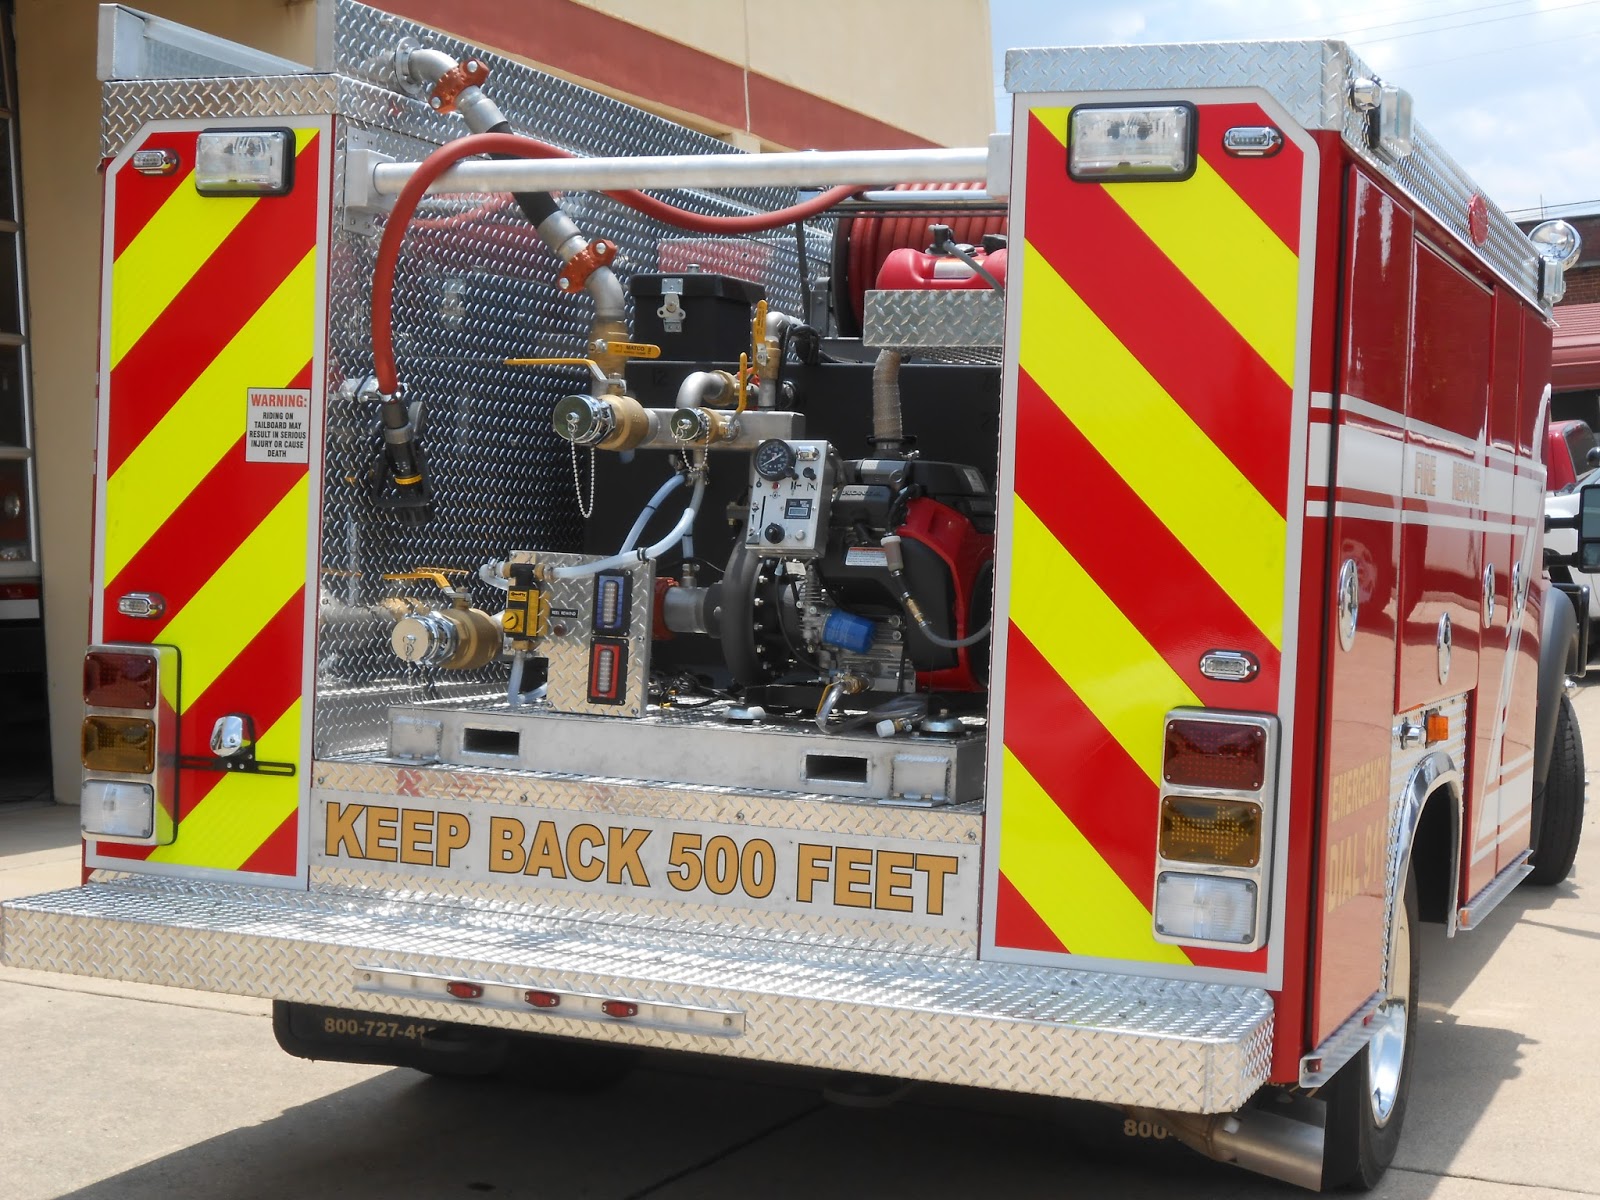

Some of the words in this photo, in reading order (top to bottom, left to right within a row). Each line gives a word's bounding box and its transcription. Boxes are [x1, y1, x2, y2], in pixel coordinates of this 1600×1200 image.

[251, 394, 307, 407] WARNING:
[254, 421, 287, 429] TAILBOARD
[281, 431, 306, 439] SERIOUS
[1414, 452, 1436, 496] FIRE
[1331, 755, 1388, 822] EMERGENCY
[325, 801, 471, 868] KEEP
[489, 816, 653, 888] BACK
[667, 832, 776, 899] 500
[796, 843, 959, 916] FEET
[1327, 832, 1360, 913] DIAL
[324, 1018, 437, 1039] 800-727-41
